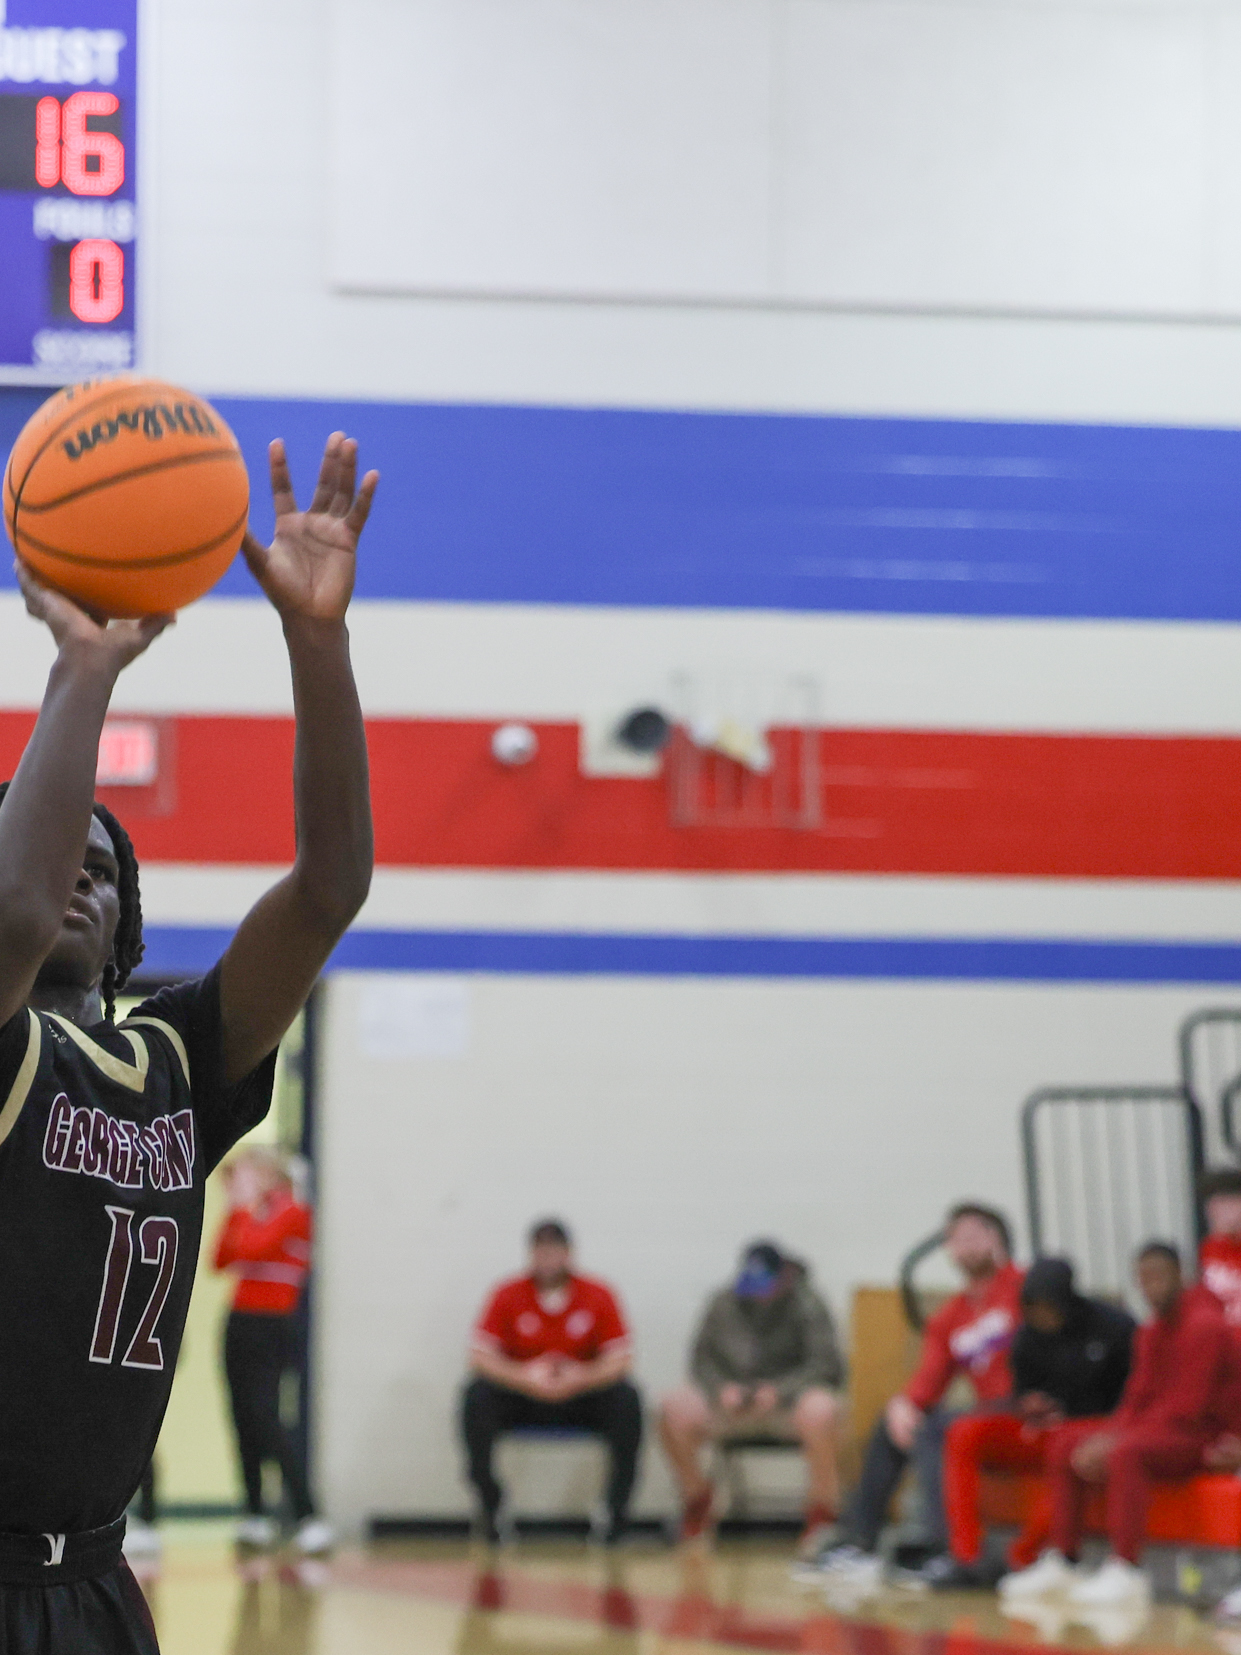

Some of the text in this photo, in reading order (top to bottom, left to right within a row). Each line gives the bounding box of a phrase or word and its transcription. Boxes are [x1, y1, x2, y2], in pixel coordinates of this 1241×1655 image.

[35, 92, 125, 196] 16
[69, 239, 125, 323] 0
[62, 401, 219, 462] Wilson
[43, 1092, 144, 1189] GEORGE
[89, 1205, 179, 1370] 12
